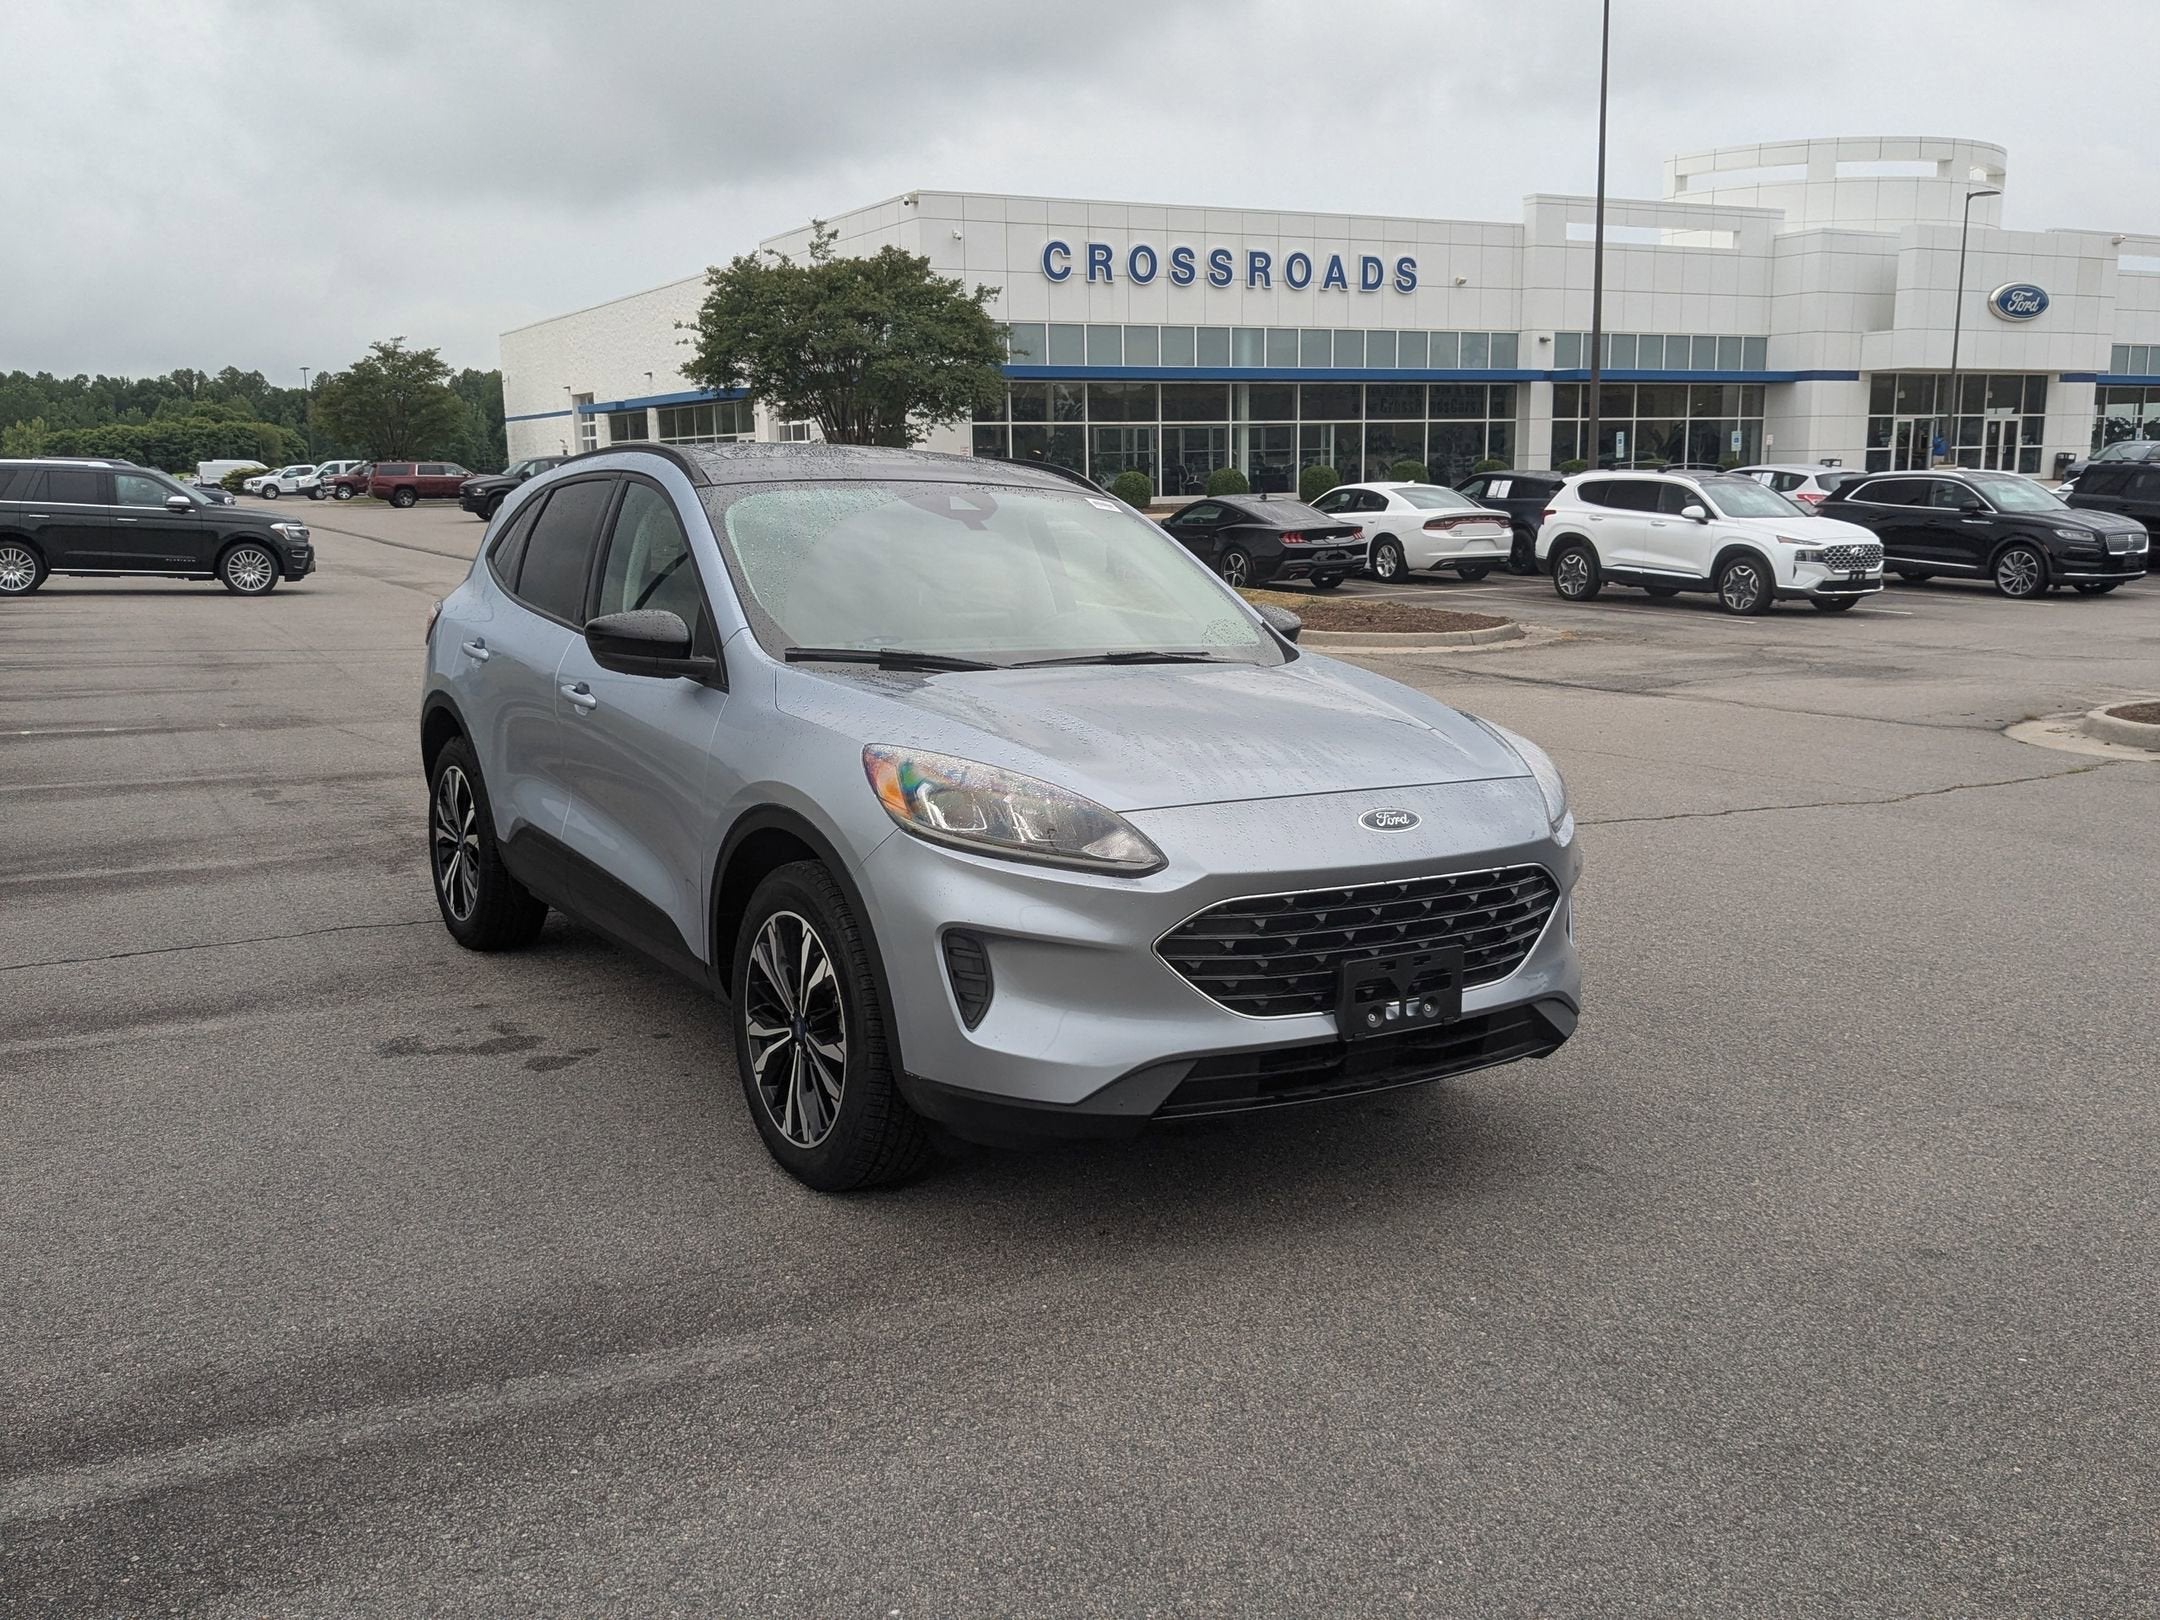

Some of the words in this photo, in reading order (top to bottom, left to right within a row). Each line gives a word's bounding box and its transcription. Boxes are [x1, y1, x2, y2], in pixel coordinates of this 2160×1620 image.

[1041, 240, 1419, 294] CROSSROADS
[2007, 290, 2041, 312] Ford
[1375, 811, 1410, 827] Ford
